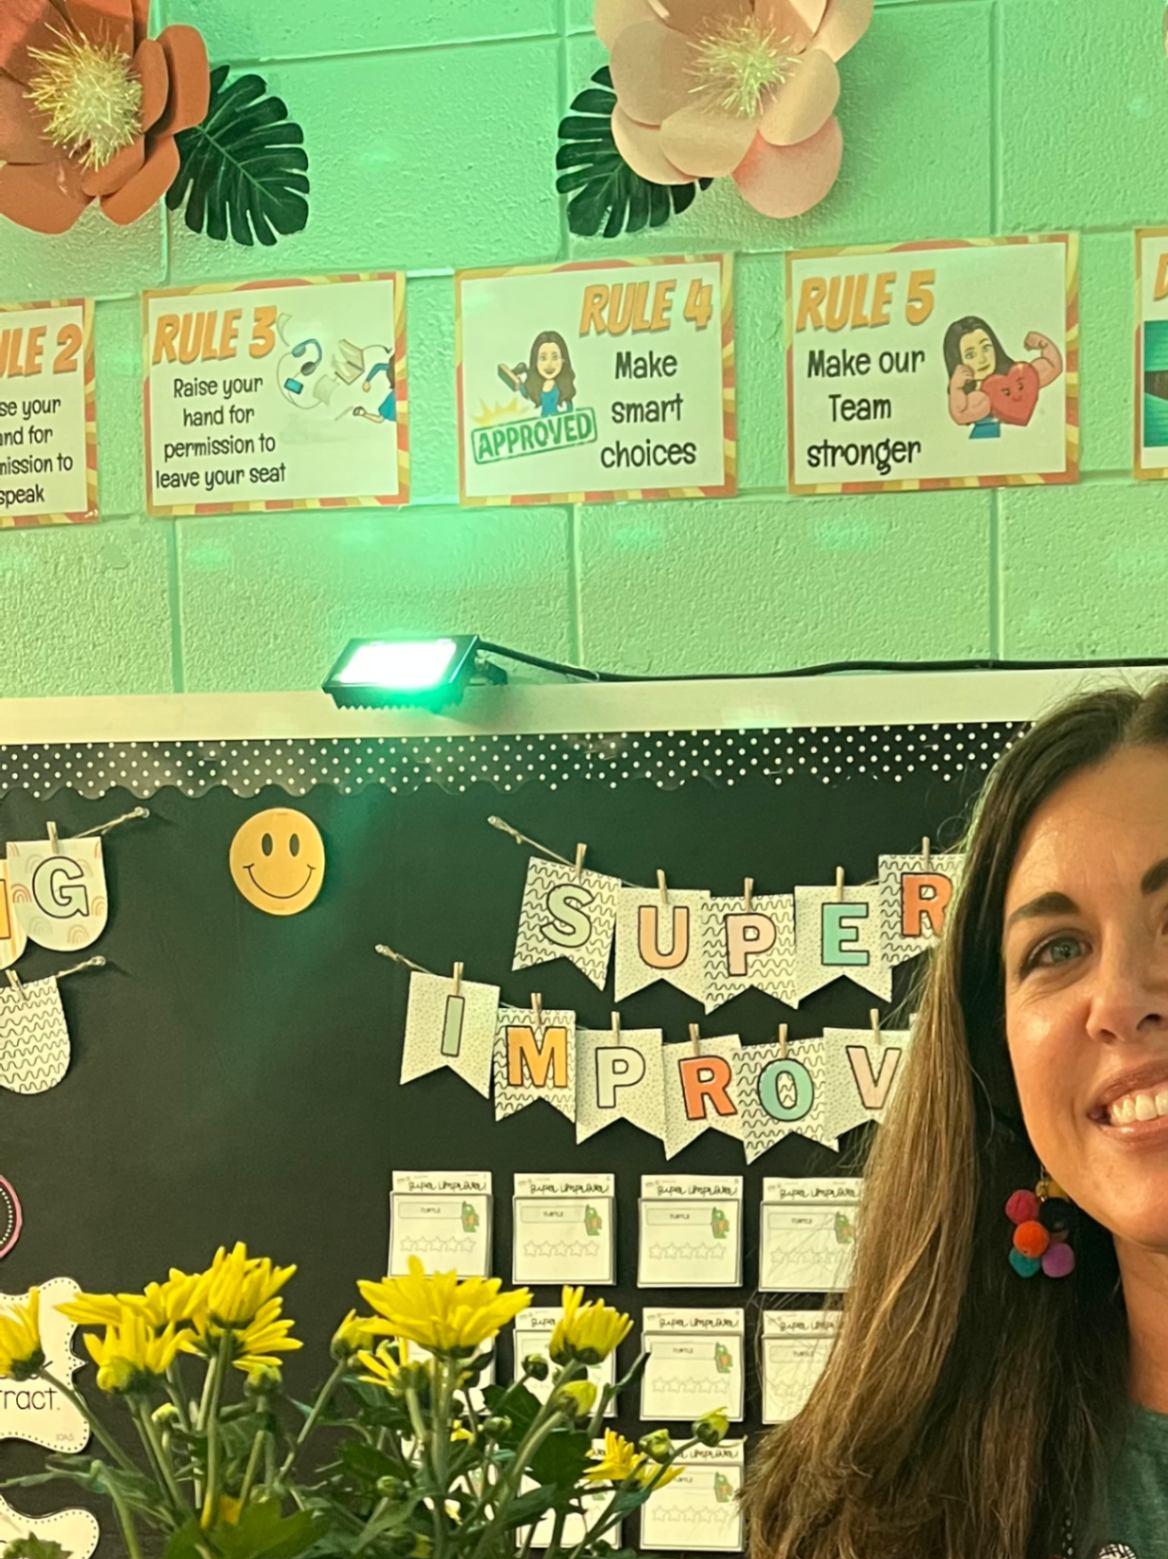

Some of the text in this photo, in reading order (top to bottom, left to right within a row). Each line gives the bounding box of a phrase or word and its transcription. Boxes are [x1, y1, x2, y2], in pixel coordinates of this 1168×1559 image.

[579, 278, 714, 338] RULE 4
[796, 268, 936, 332] RULE 5
[53, 323, 83, 374] 2
[152, 305, 278, 366] RULE 3
[615, 350, 678, 380] Make
[807, 346, 926, 379] Make our
[173, 377, 264, 400] Raise your
[22, 399, 62, 420] your
[183, 404, 255, 427] hand for
[611, 393, 684, 424] smart
[829, 392, 892, 423] Team
[28, 424, 53, 444] for
[164, 433, 276, 462] permission to
[478, 412, 592, 460] APPROVED
[57, 453, 73, 472] to
[600, 439, 697, 468] choices
[806, 437, 922, 475] stronger
[156, 462, 286, 491] leave your seat
[540, 872, 953, 978] SUPER
